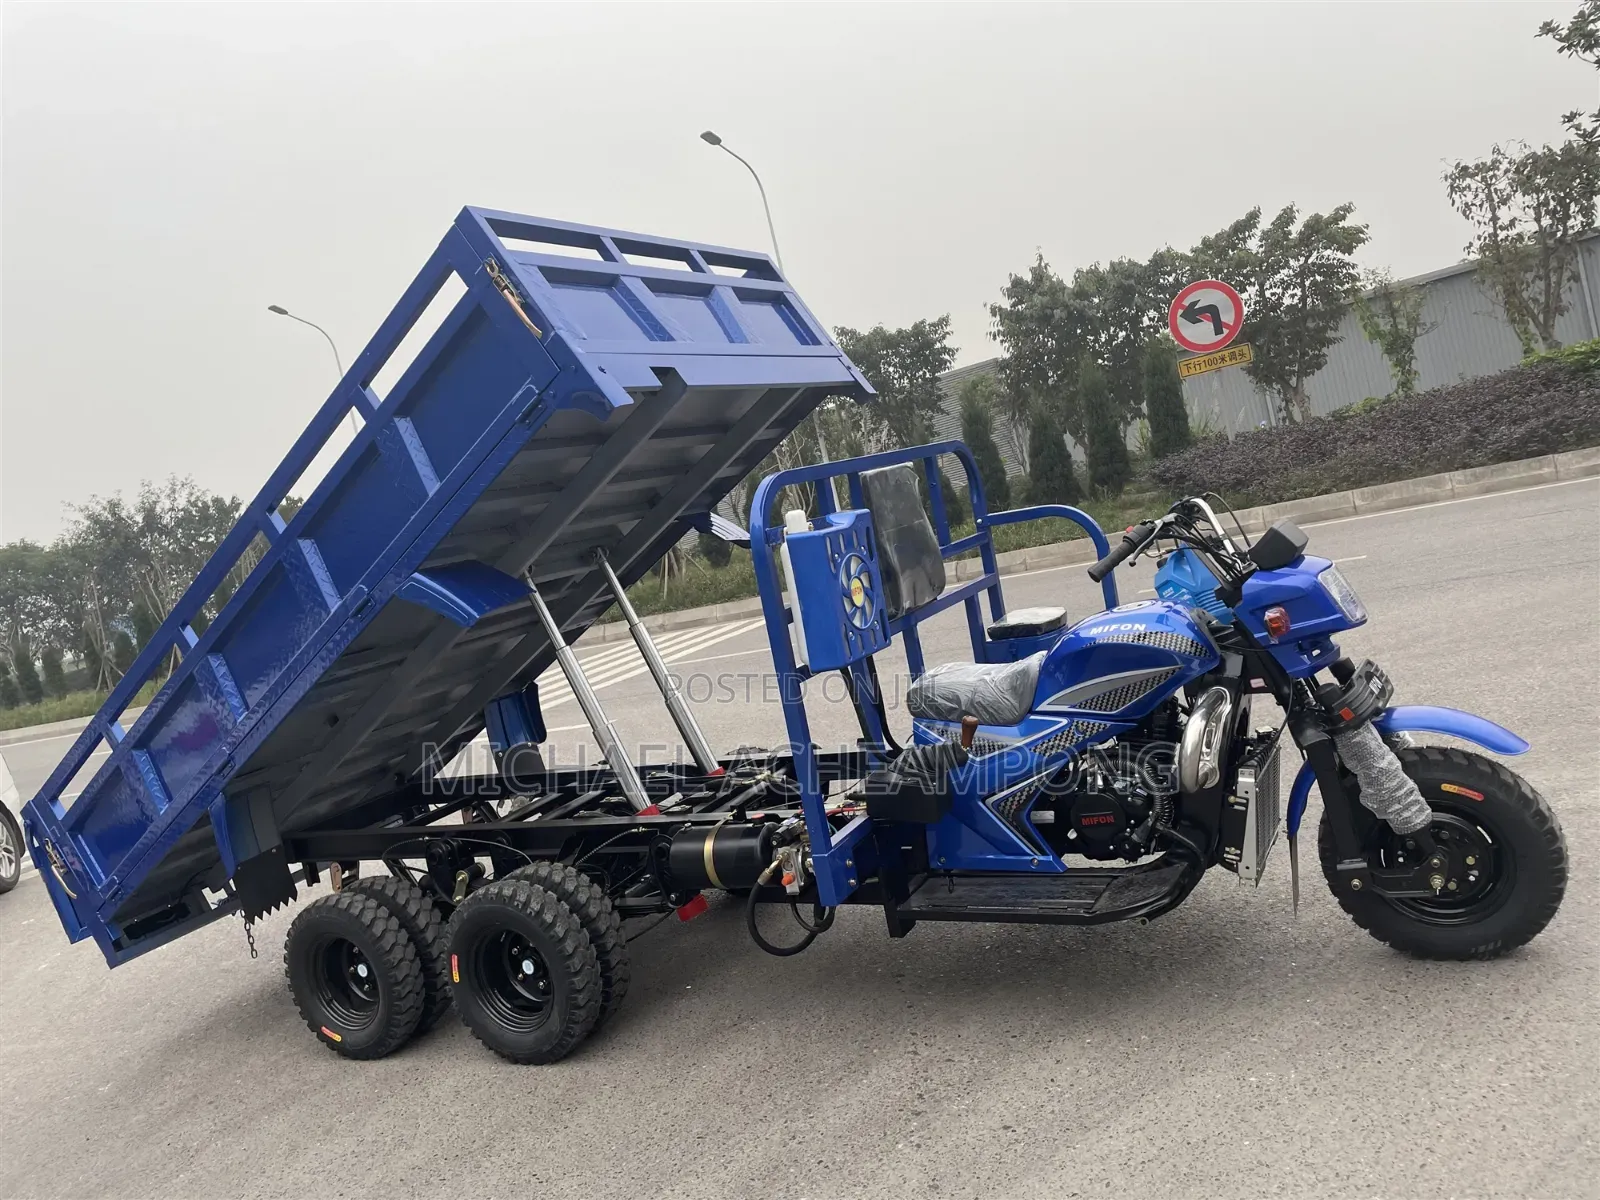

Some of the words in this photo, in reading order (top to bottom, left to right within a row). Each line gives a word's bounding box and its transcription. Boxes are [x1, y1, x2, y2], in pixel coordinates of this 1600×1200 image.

[1183, 348, 1247, 374] 下行100米调头
[1089, 623, 1147, 635] MIFON
[1081, 815, 1115, 826] MIFON
